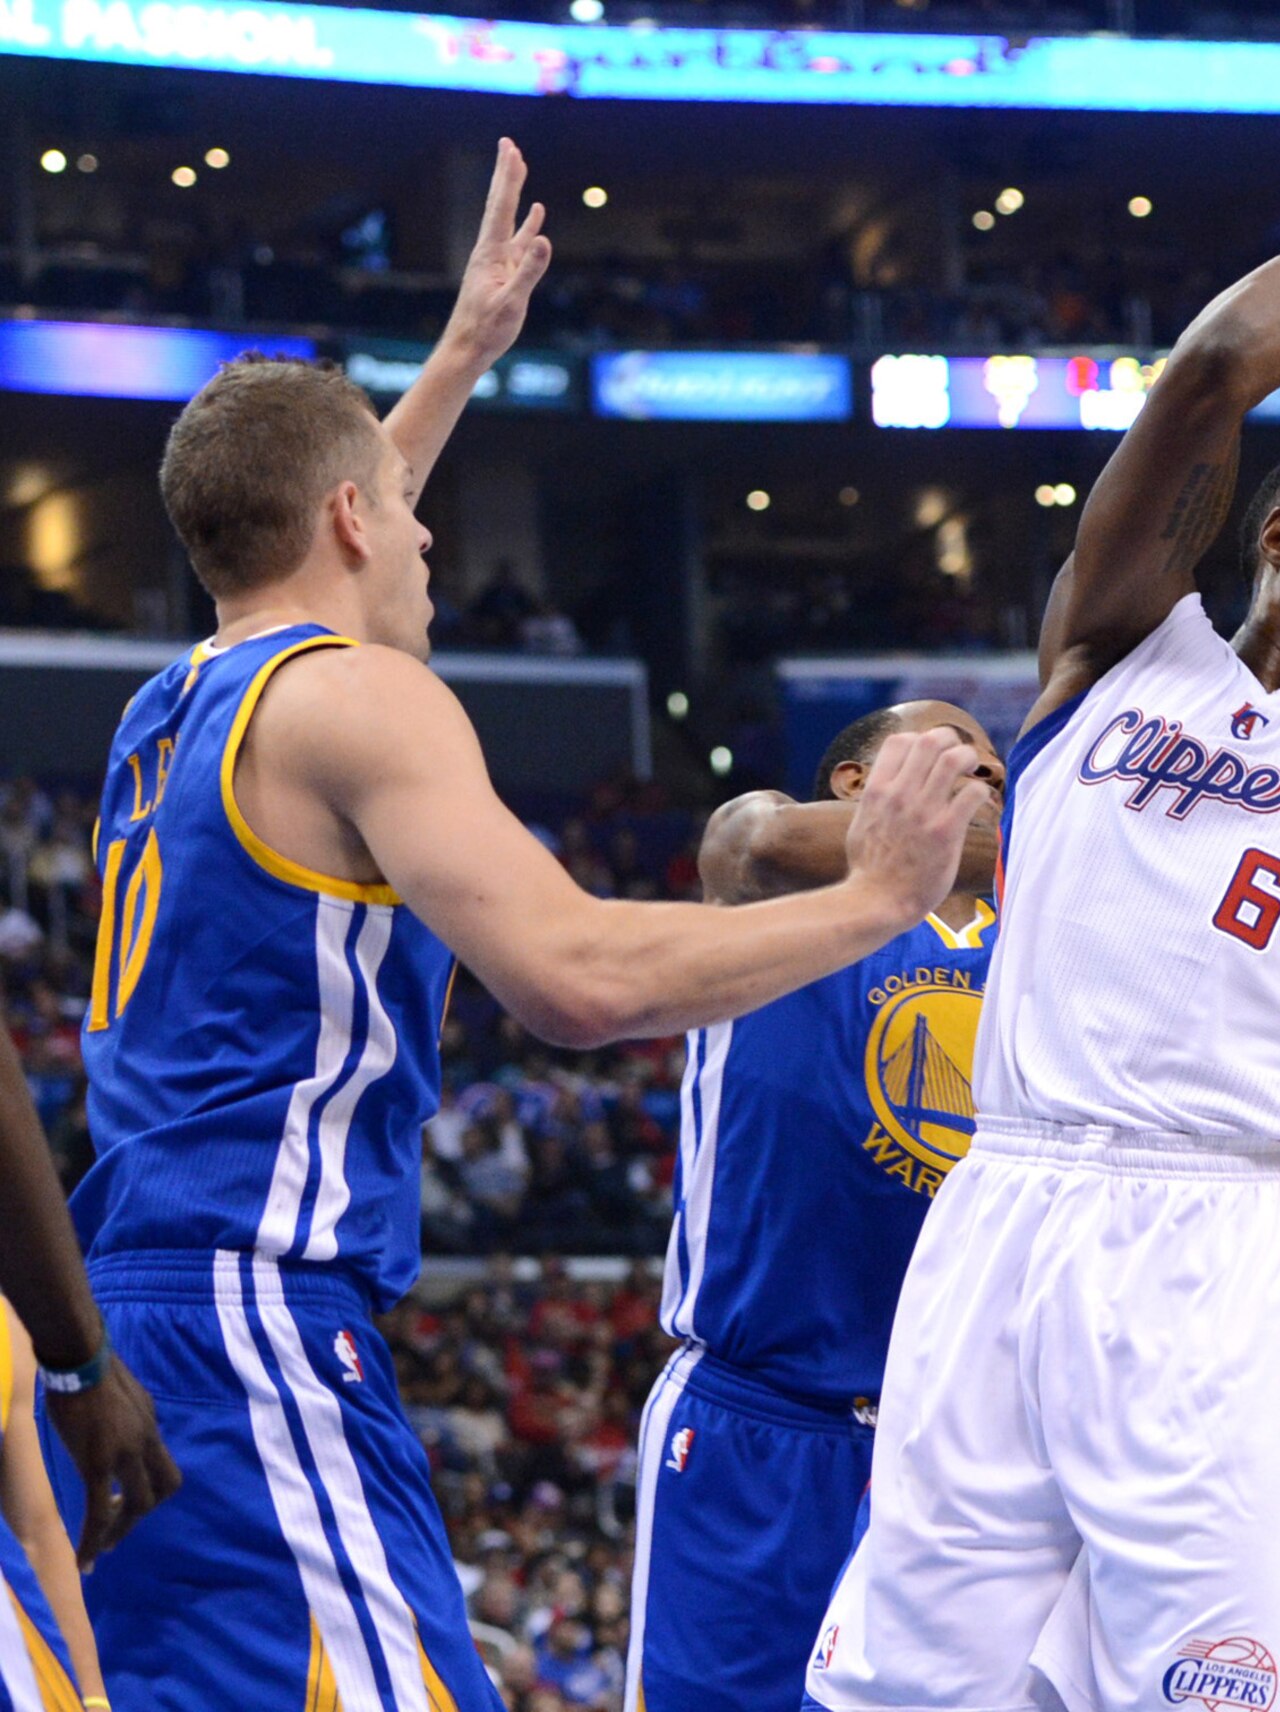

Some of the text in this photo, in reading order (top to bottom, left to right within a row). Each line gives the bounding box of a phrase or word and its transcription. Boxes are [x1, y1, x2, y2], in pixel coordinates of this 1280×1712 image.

[87, 826, 162, 1032] 10
[867, 967, 972, 1005] GOLDEN
[1162, 1658, 1270, 1705] CLIPPERS
[1205, 1662, 1273, 1684] LOS ANGELES
